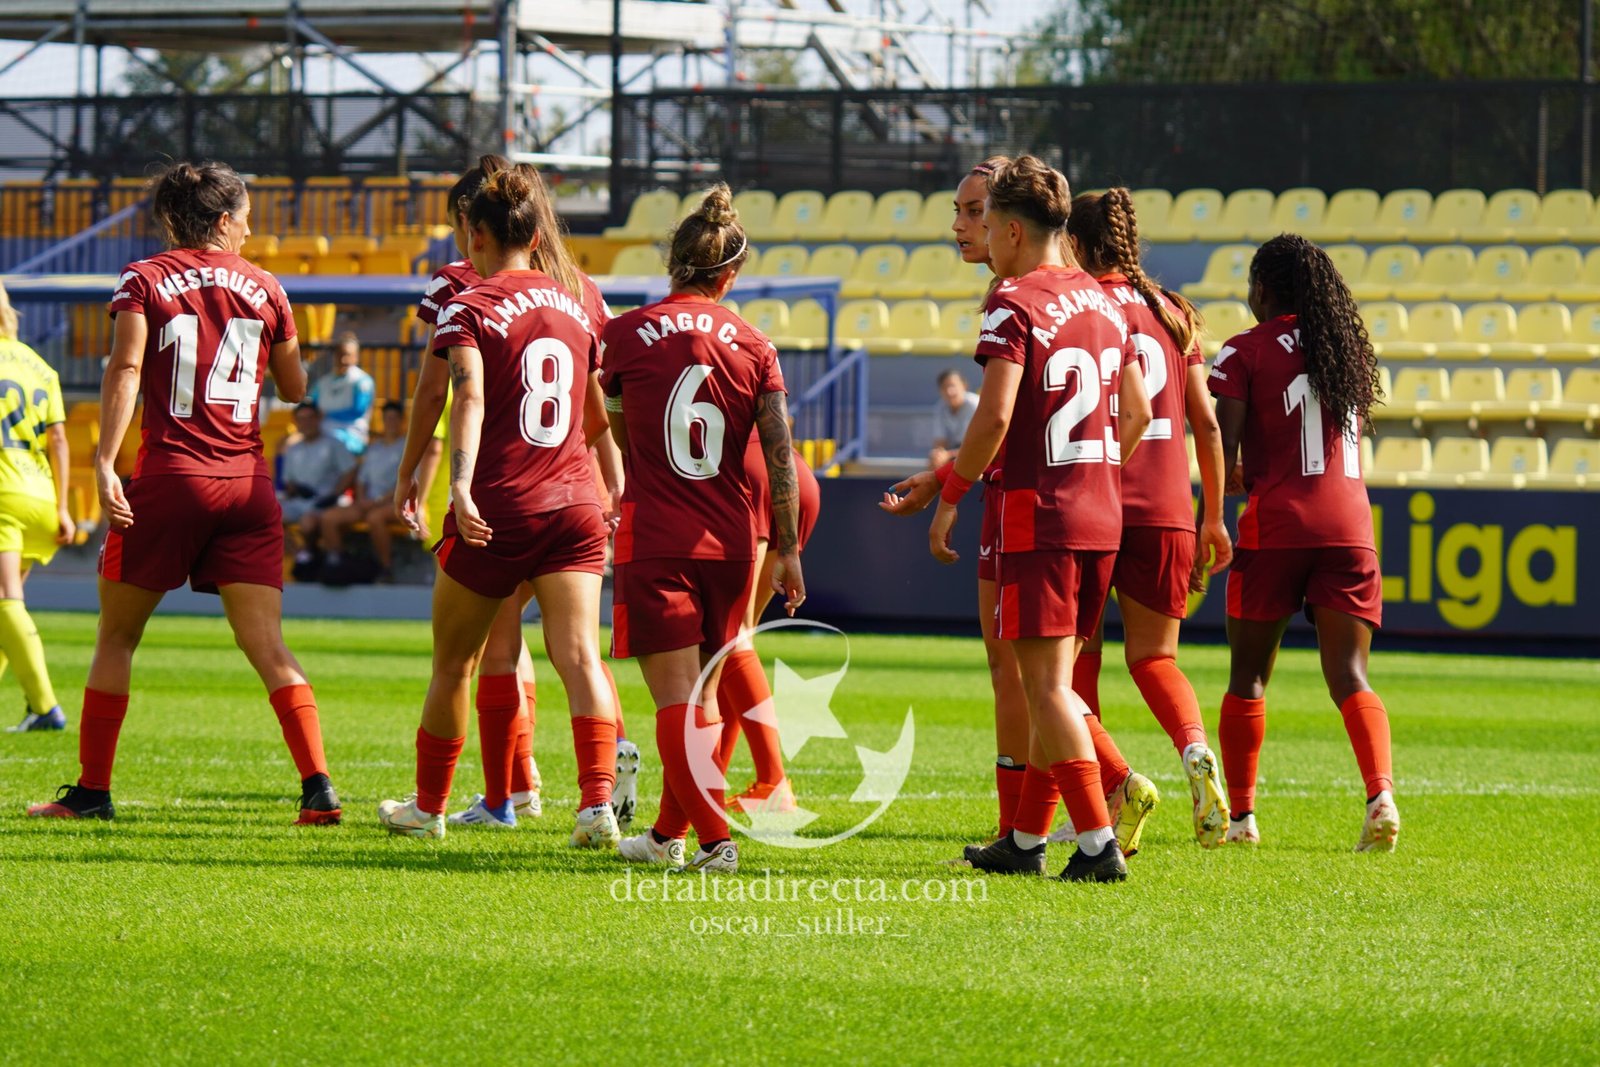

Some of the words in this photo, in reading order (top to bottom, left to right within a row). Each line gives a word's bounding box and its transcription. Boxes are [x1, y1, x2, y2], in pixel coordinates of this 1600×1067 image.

[156, 267, 268, 310] MESEGUER
[636, 312, 714, 347] NAGO
[717, 322, 739, 351] C.
[158, 313, 264, 422] 14
[519, 337, 574, 448] 8
[664, 364, 726, 480] 6
